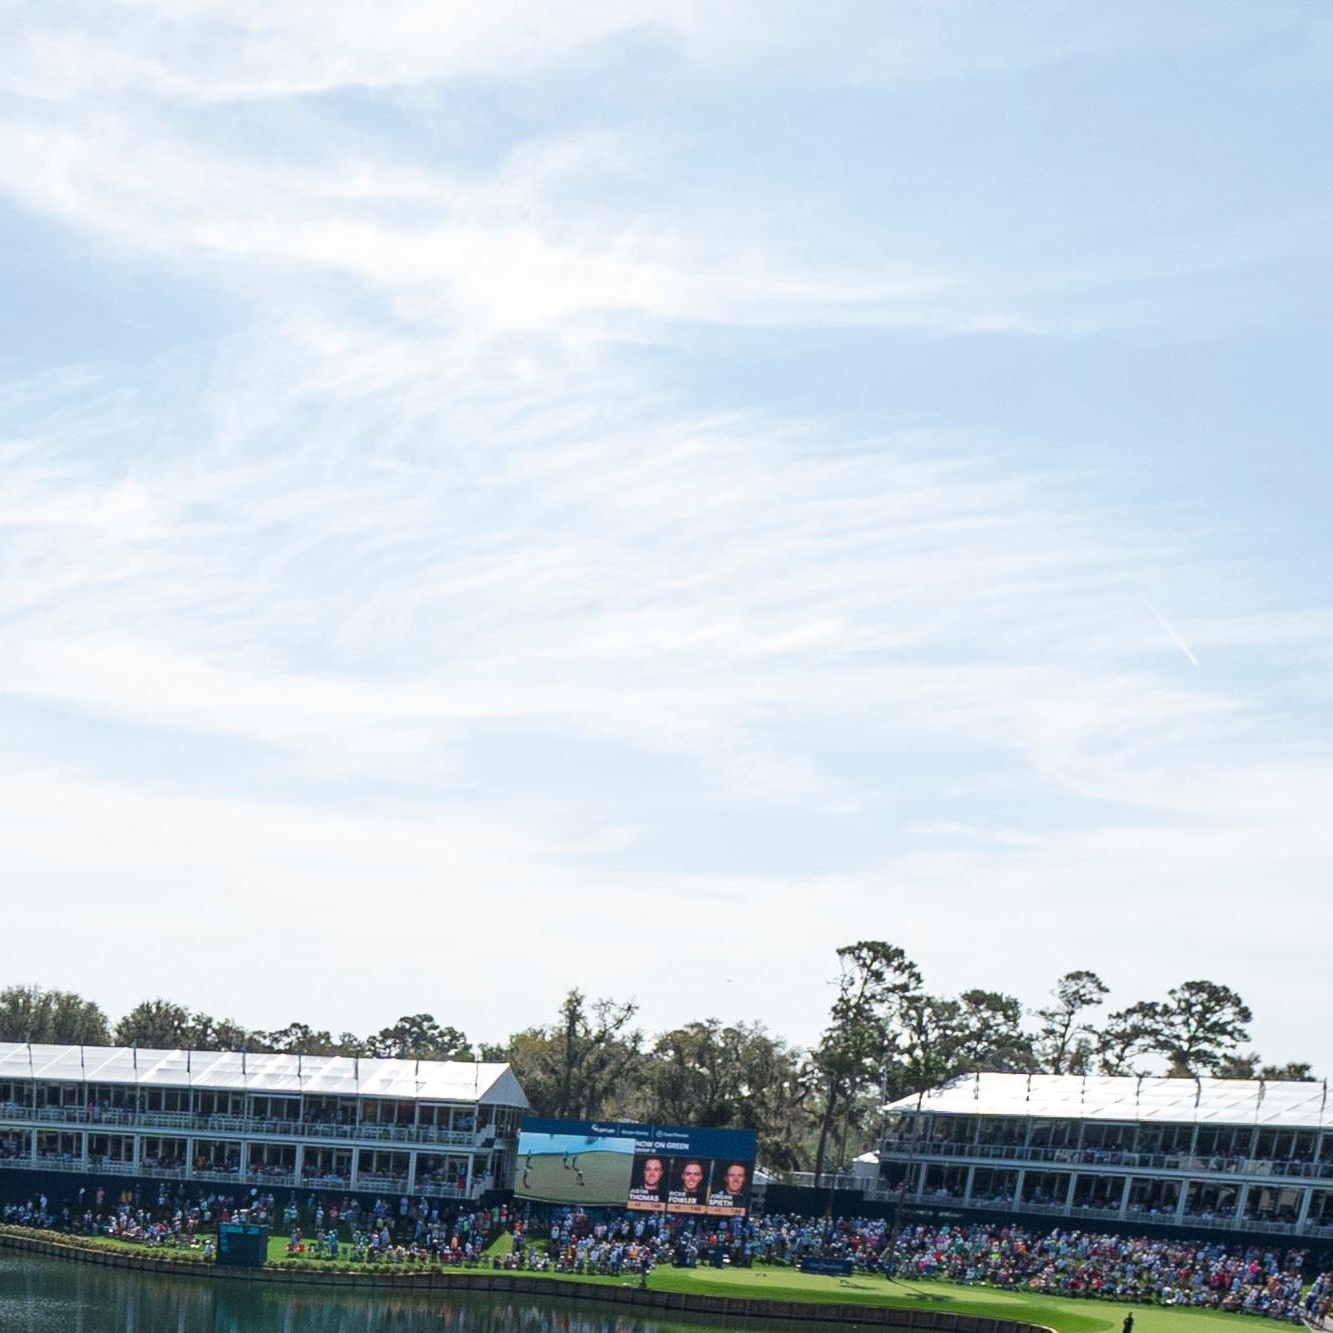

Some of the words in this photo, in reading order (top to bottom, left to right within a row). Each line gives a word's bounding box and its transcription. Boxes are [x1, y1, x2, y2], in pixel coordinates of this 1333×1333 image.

[636, 1140, 653, 1148] NOW
[654, 1141, 665, 1149] ON
[666, 1142, 689, 1150] GREEN
